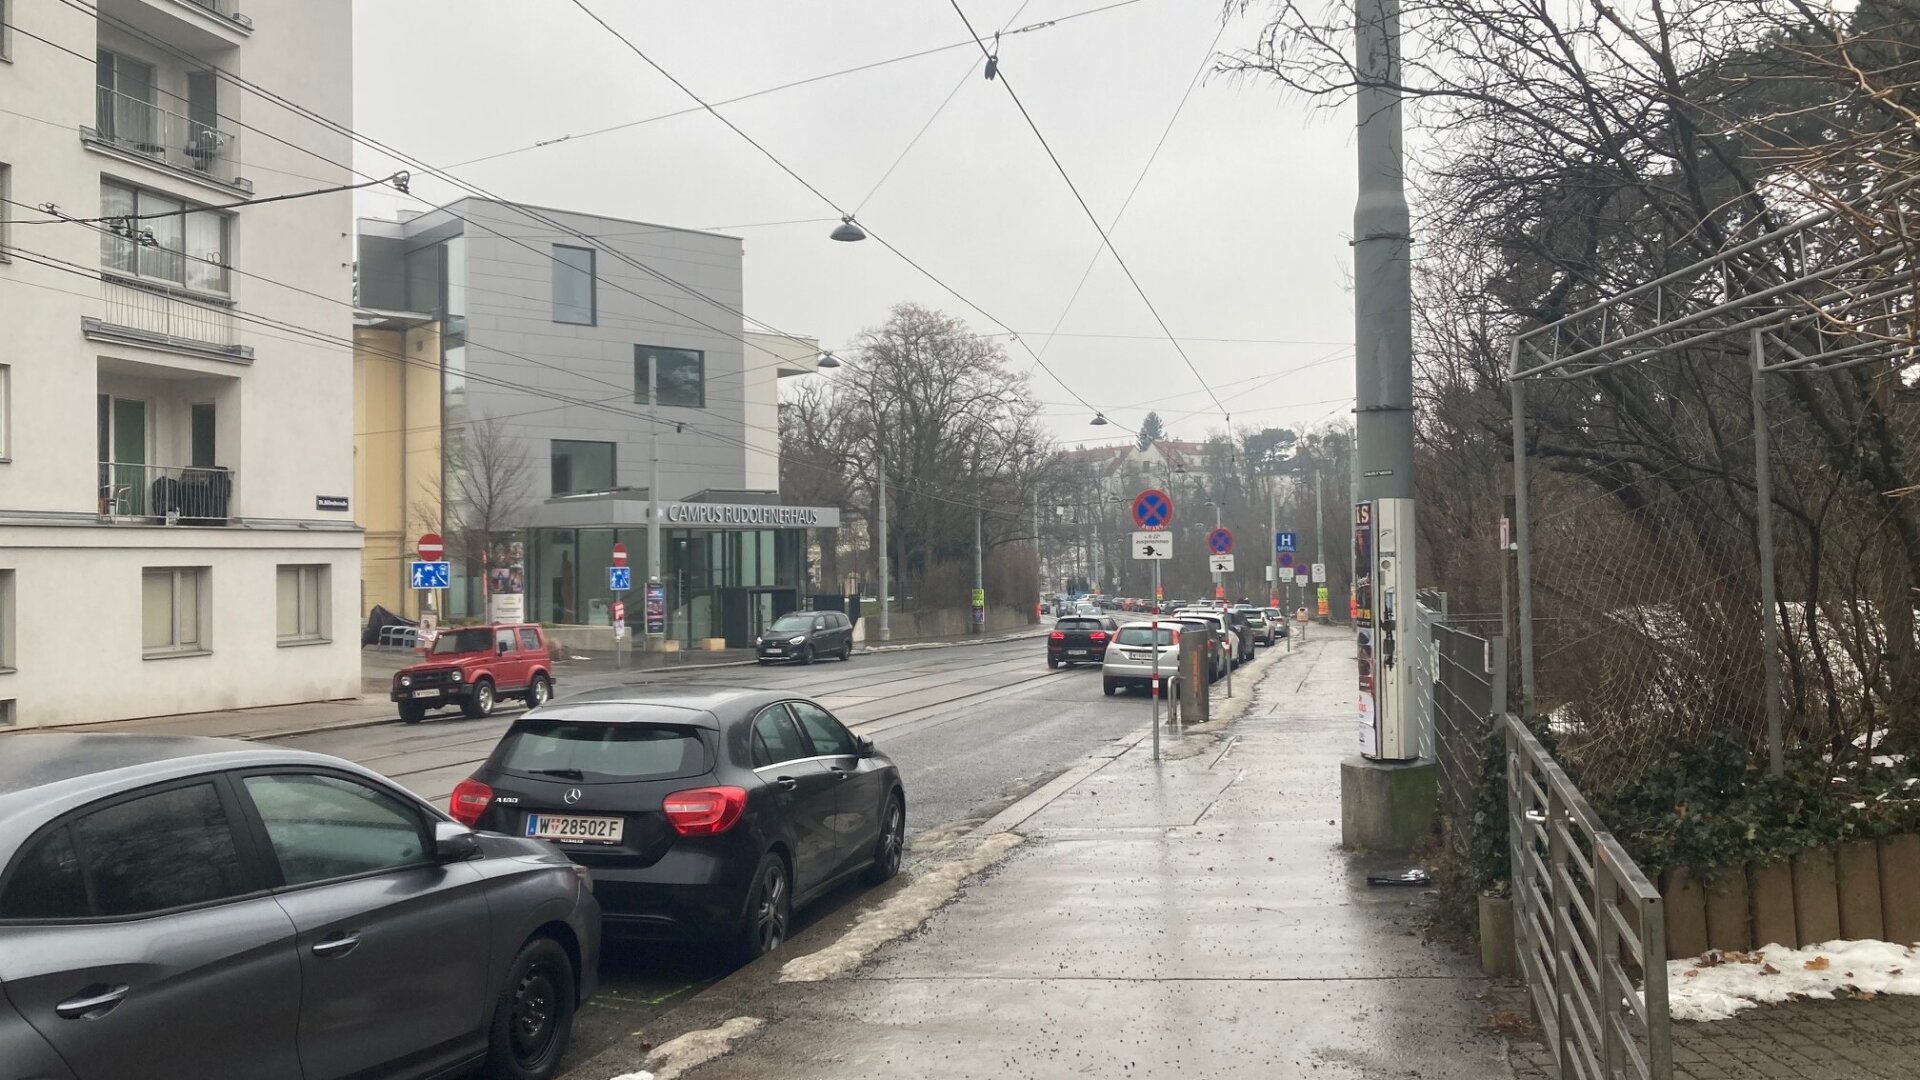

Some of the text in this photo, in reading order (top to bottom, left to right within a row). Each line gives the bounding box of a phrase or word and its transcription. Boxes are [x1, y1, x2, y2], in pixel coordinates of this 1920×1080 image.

[667, 504, 818, 525] CAMPUS RUDOLFINERHAUS
[1281, 534, 1291, 546] H
[539, 818, 550, 834] W
